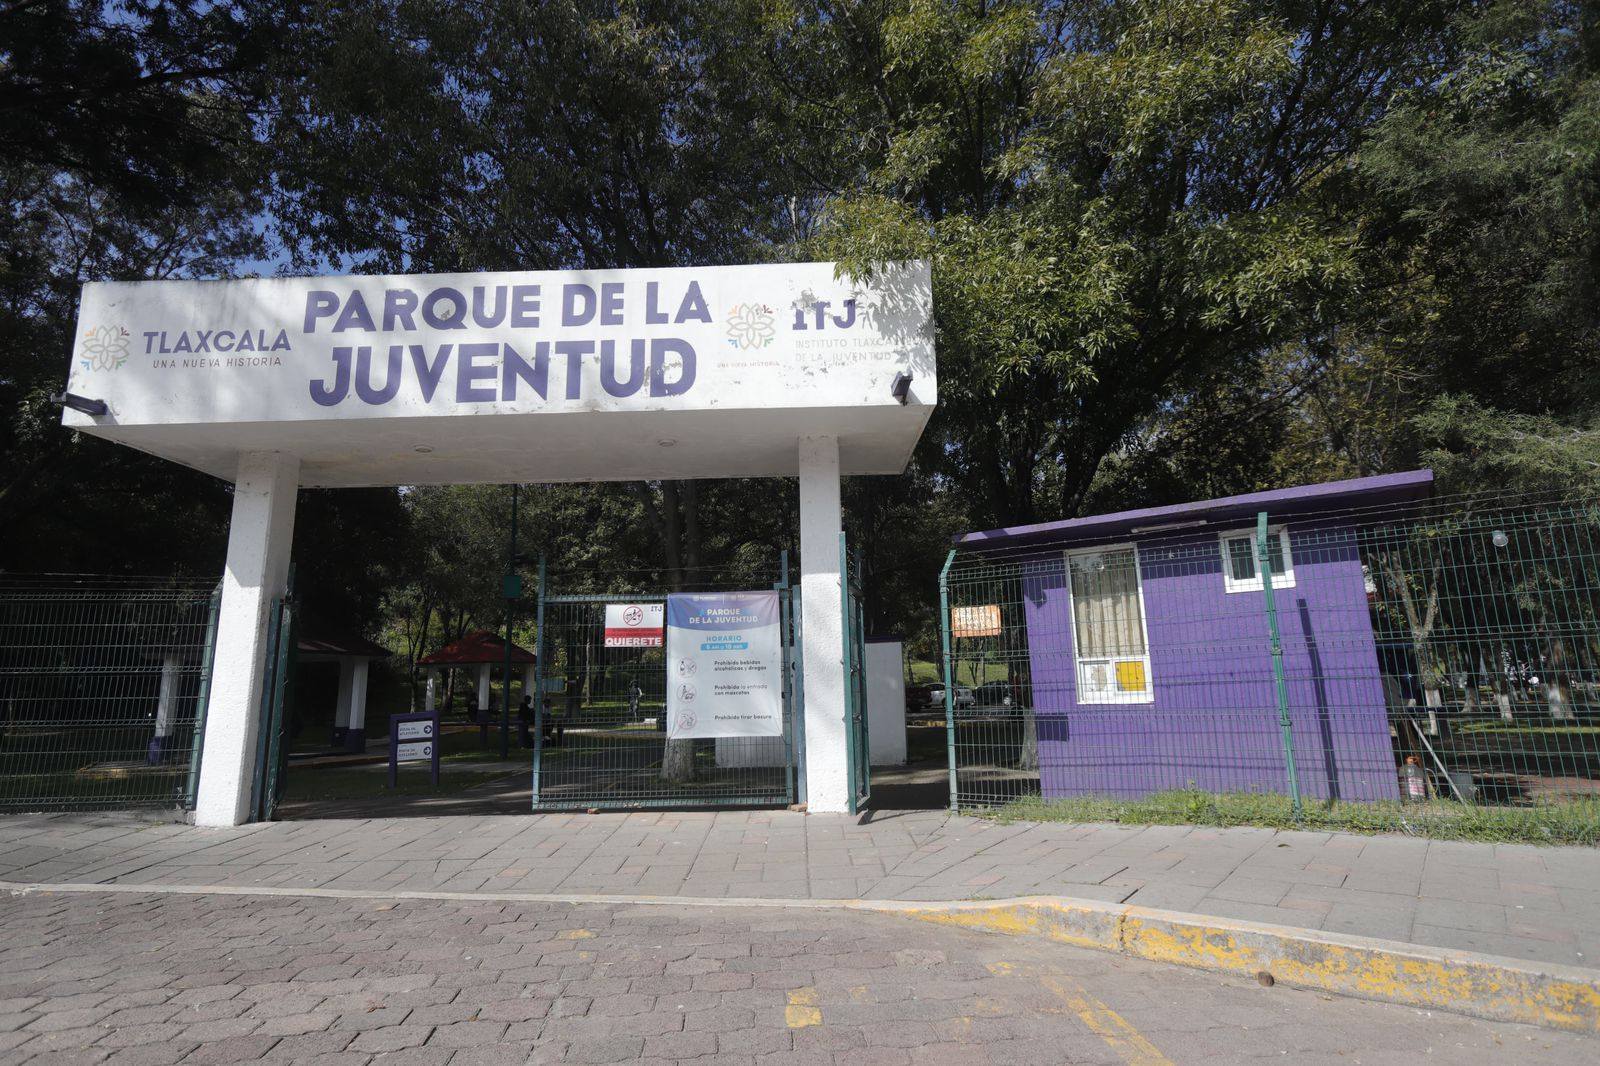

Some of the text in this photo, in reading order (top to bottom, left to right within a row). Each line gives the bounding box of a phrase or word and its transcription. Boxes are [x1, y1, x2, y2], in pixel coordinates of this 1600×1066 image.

[303, 280, 712, 333] PARQUE DE LA
[143, 328, 291, 354] TLAXCALA
[795, 338, 848, 349] INSTITUTO
[832, 351, 892, 361] JUVENTUD
[152, 356, 282, 369] UNA NUEVA HISTORIA
[309, 337, 698, 407] JUVENTUD
[707, 608, 741, 616] PARQUE
[702, 616, 712, 624] LA
[714, 615, 759, 623] JUVENTUD
[605, 637, 663, 646] QUIERETE
